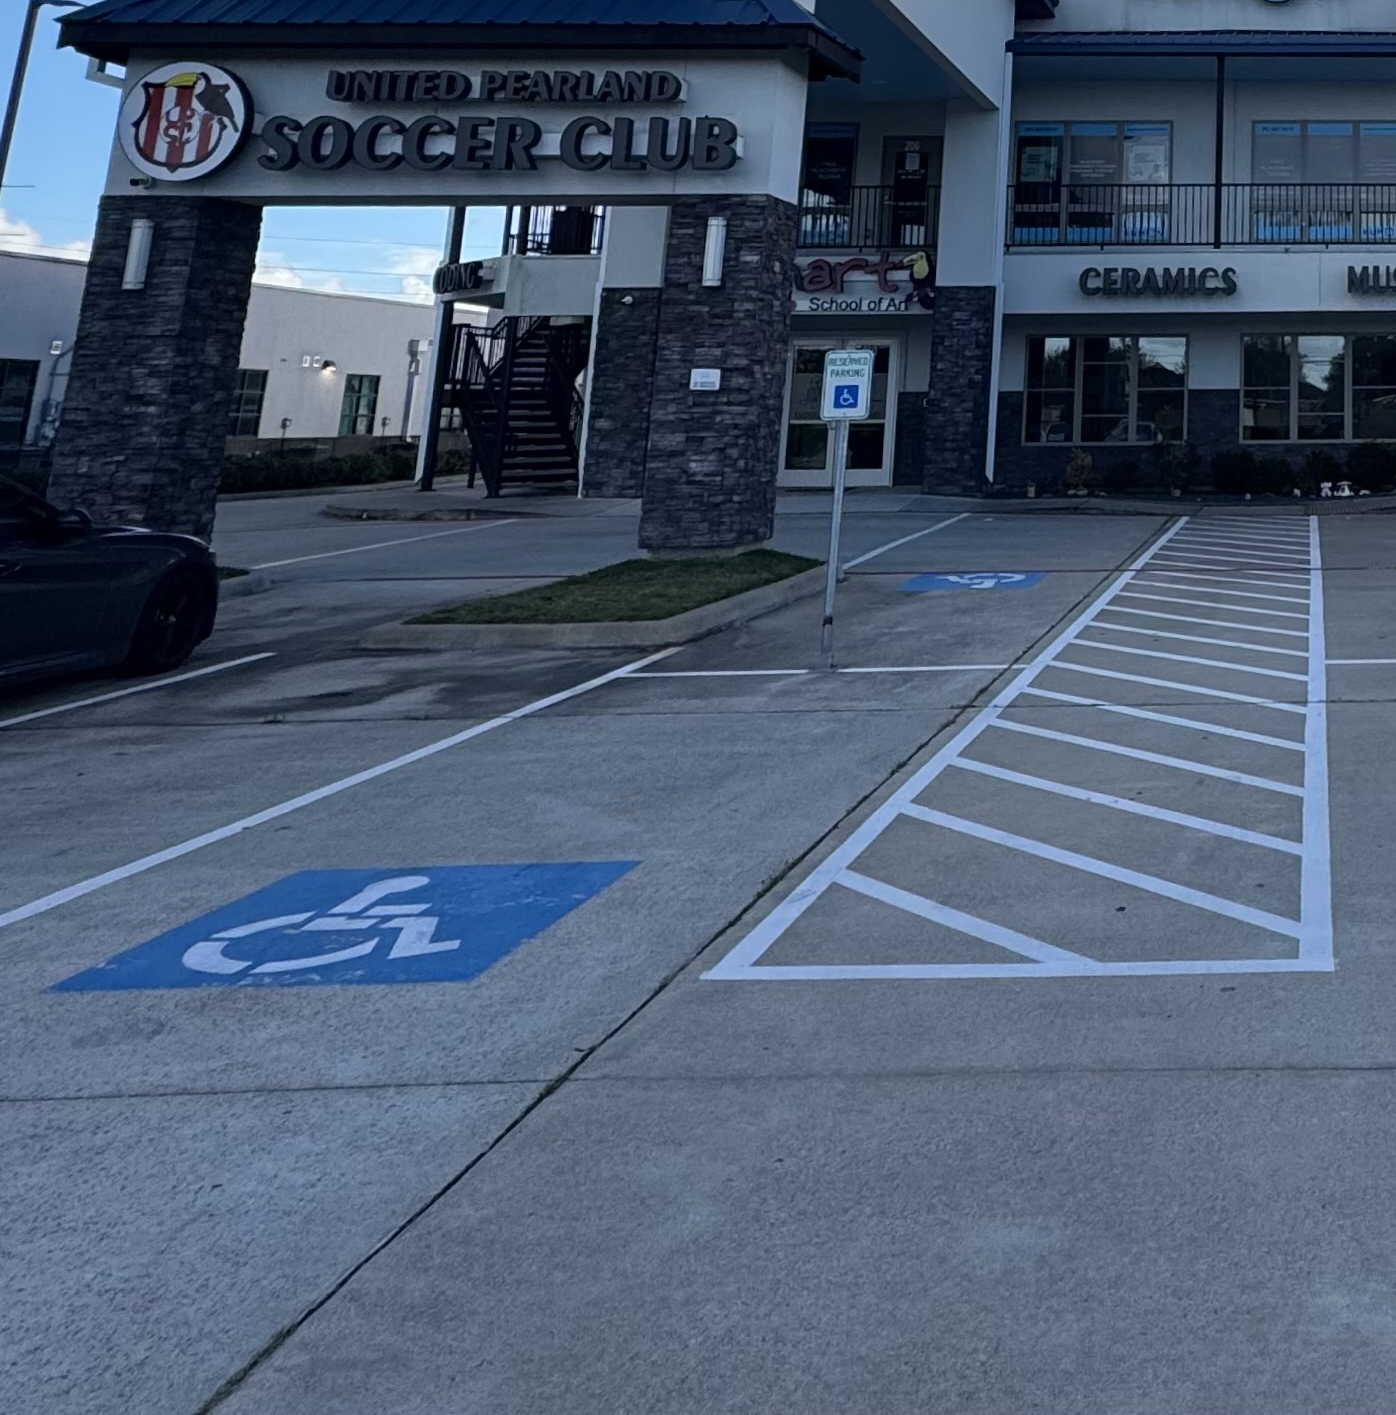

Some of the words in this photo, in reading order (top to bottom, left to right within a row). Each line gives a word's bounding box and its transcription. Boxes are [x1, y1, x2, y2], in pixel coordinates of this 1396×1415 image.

[325, 70, 472, 102] UNITED
[479, 70, 682, 102] PEARLAND
[257, 114, 542, 171] SOCCER
[559, 115, 738, 171] CLUB
[1079, 267, 1238, 296] CERAMICS
[809, 297, 864, 312] School
[867, 297, 885, 312] of
[829, 357, 868, 366] RESERVED
[830, 369, 866, 377] PARKING
